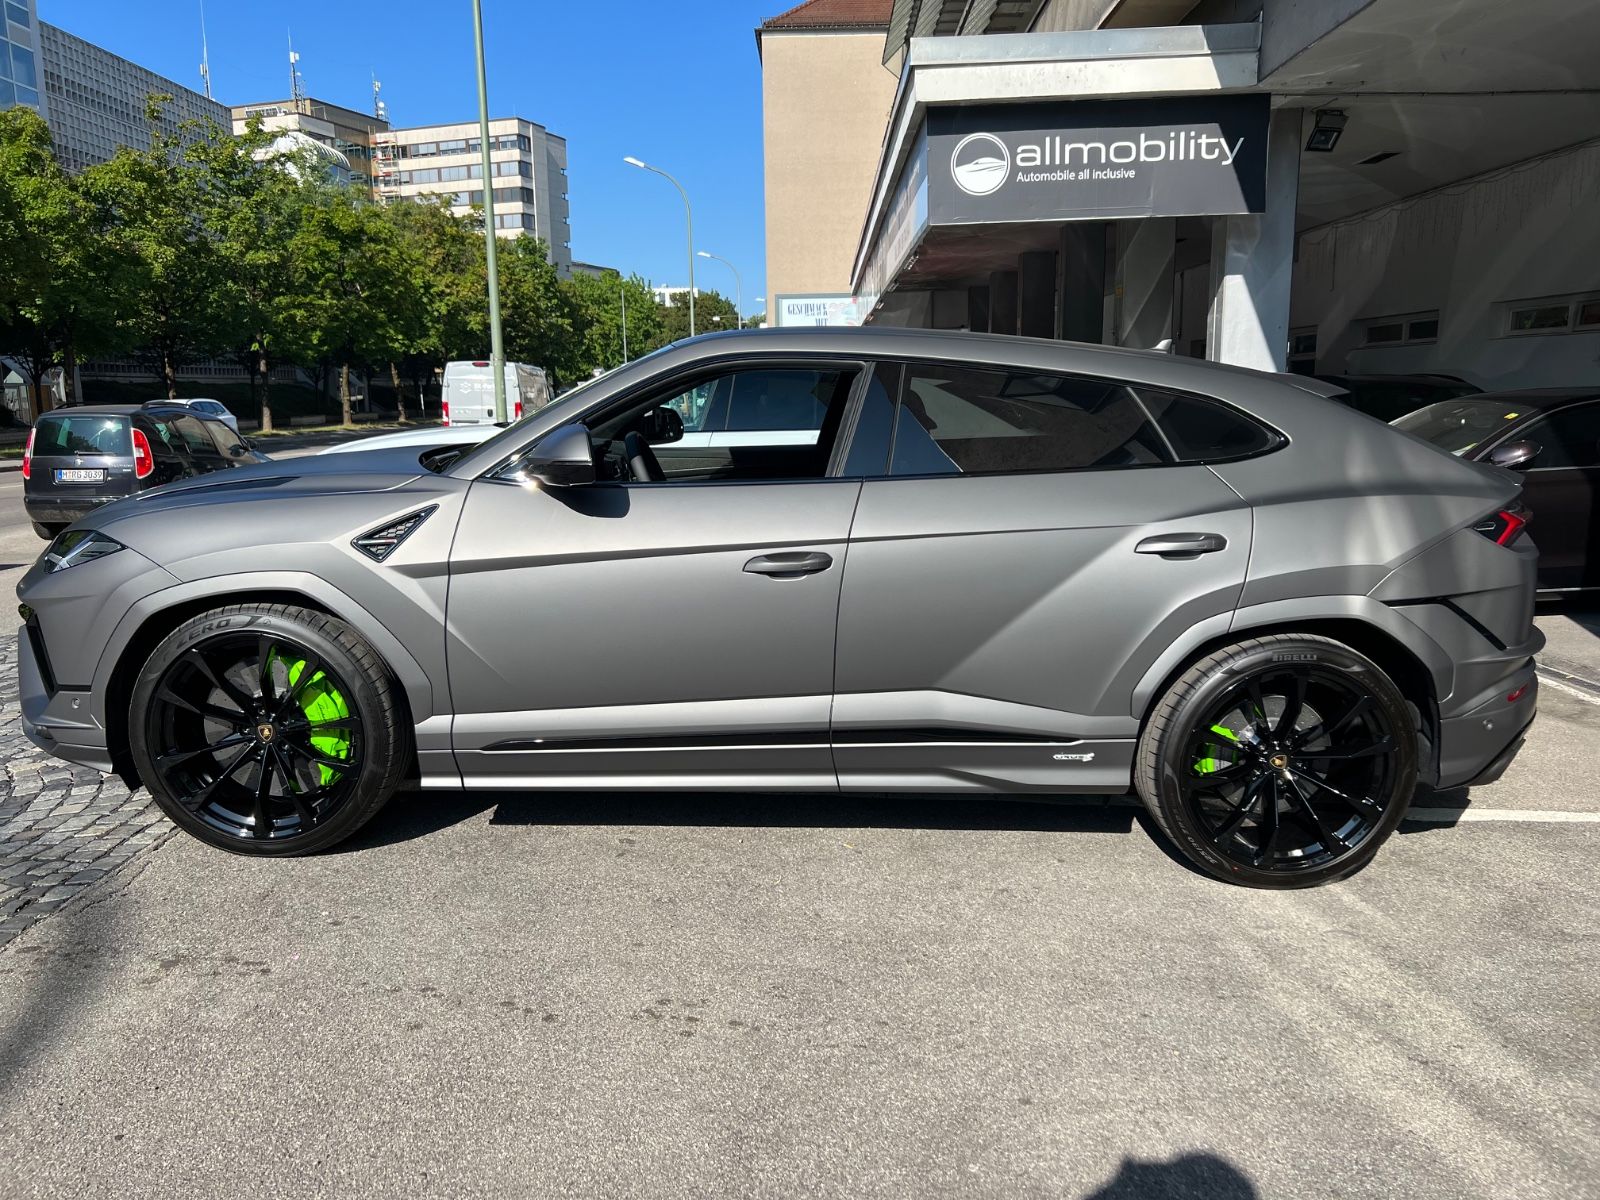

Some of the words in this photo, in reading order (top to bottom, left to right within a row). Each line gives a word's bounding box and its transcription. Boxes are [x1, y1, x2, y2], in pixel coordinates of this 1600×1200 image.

[1015, 131, 1245, 166] allmobility
[1016, 169, 1076, 182] Automobile
[1077, 168, 1090, 180] all
[1092, 168, 1136, 179] inclusive
[787, 303, 828, 316] GESCHMACK
[83, 470, 103, 479] 3039
